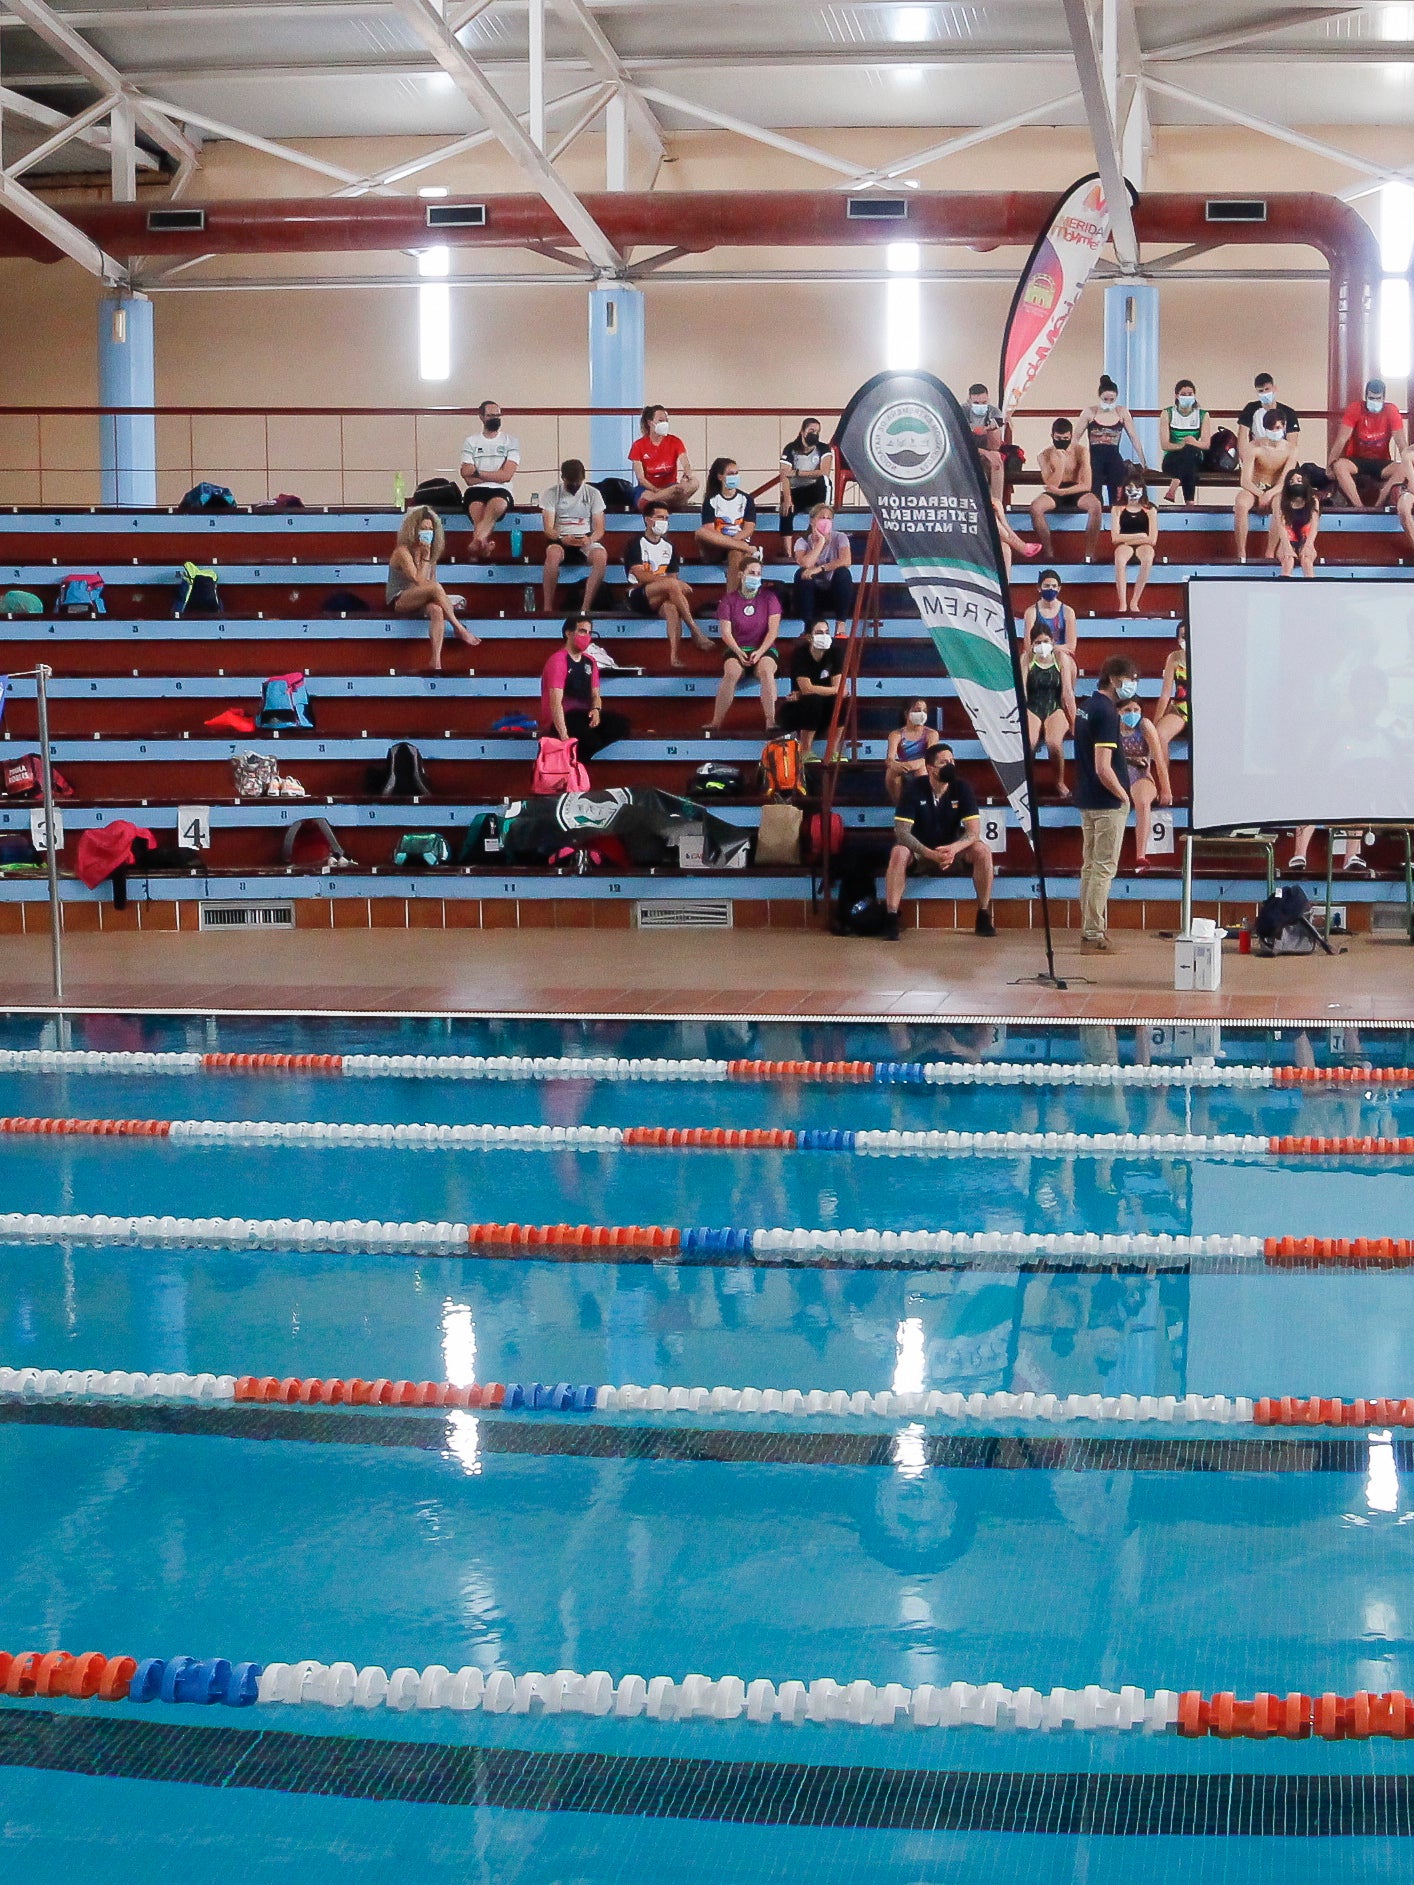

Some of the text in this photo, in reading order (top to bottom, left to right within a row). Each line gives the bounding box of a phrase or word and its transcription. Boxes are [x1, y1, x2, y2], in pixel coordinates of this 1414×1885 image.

[183, 818, 206, 846] 4
[986, 822, 998, 840] 8
[1153, 821, 1166, 842] 9
